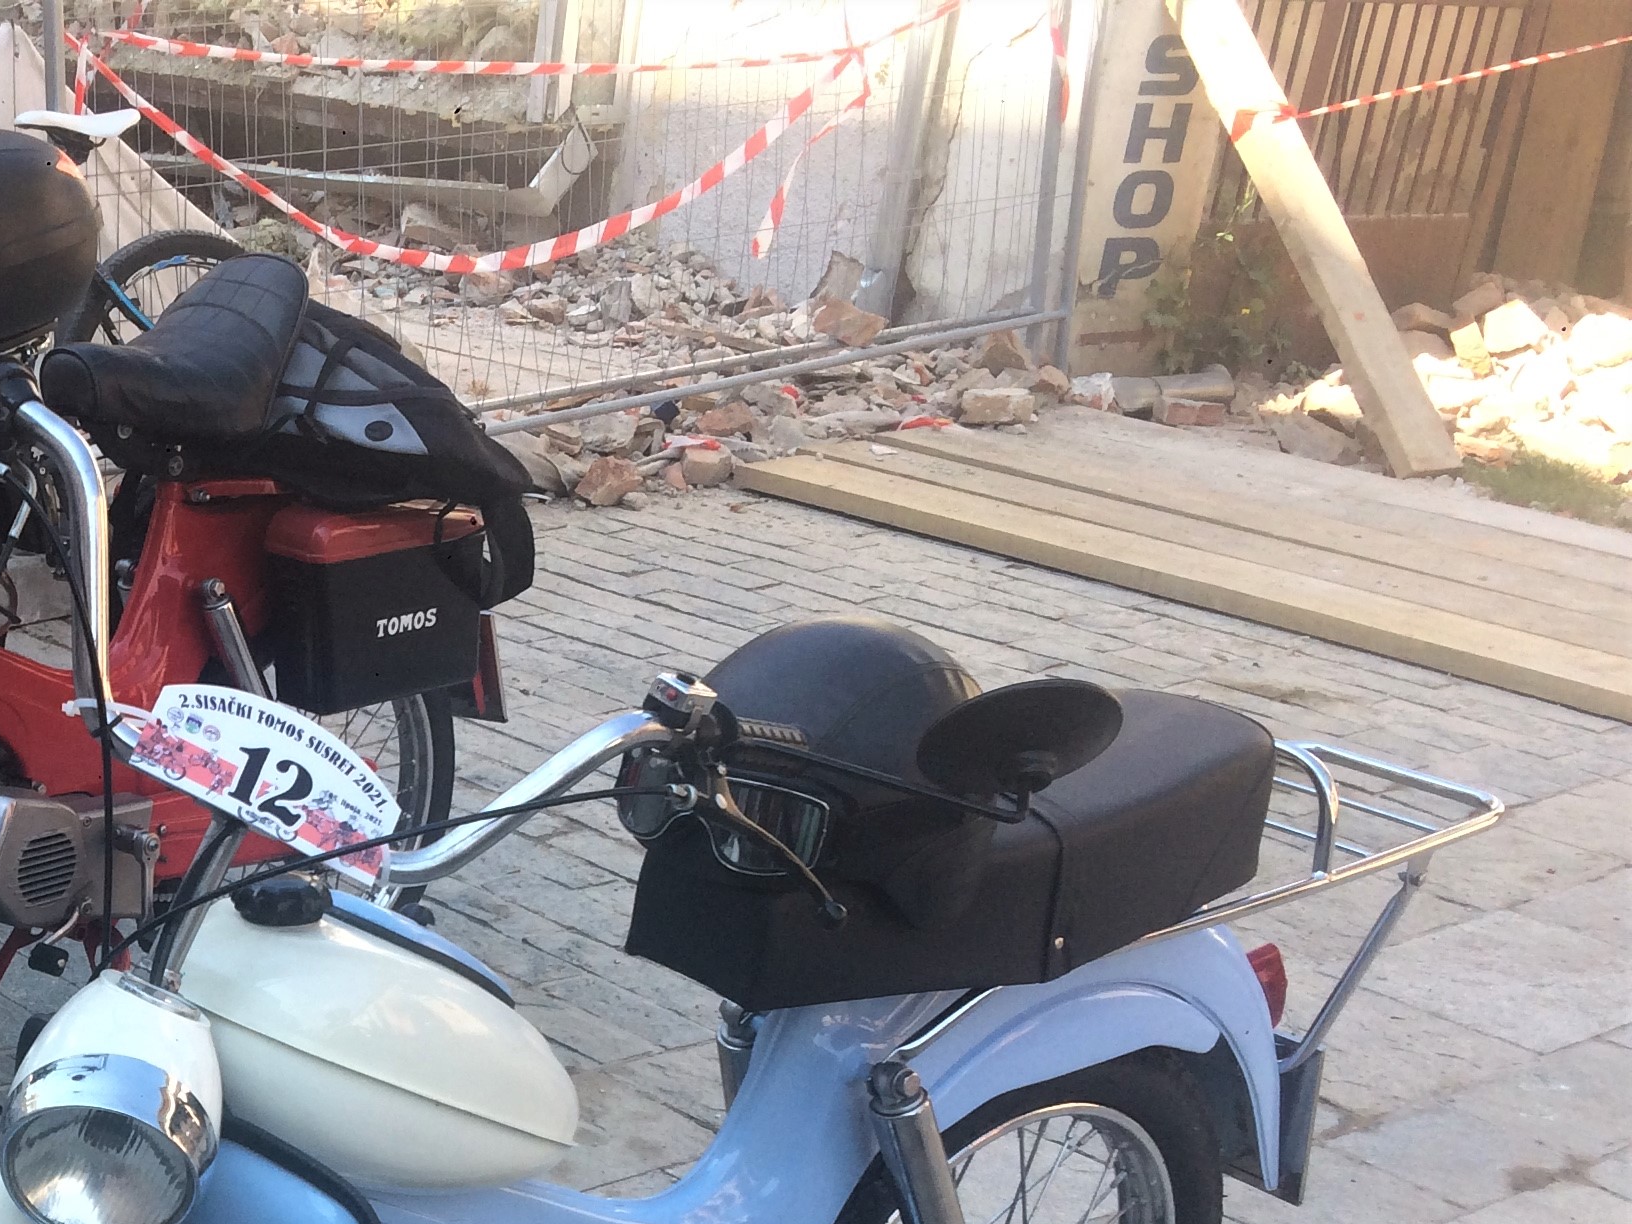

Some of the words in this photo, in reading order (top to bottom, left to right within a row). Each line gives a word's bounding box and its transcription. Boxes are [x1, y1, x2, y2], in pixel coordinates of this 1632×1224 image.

[1097, 34, 1200, 299] SHOP
[376, 607, 437, 638] TOMOS
[228, 746, 314, 827] 12
[257, 708, 305, 742] TOMOS
[305, 735, 357, 777] SUSRET
[352, 772, 388, 814] 2021.
